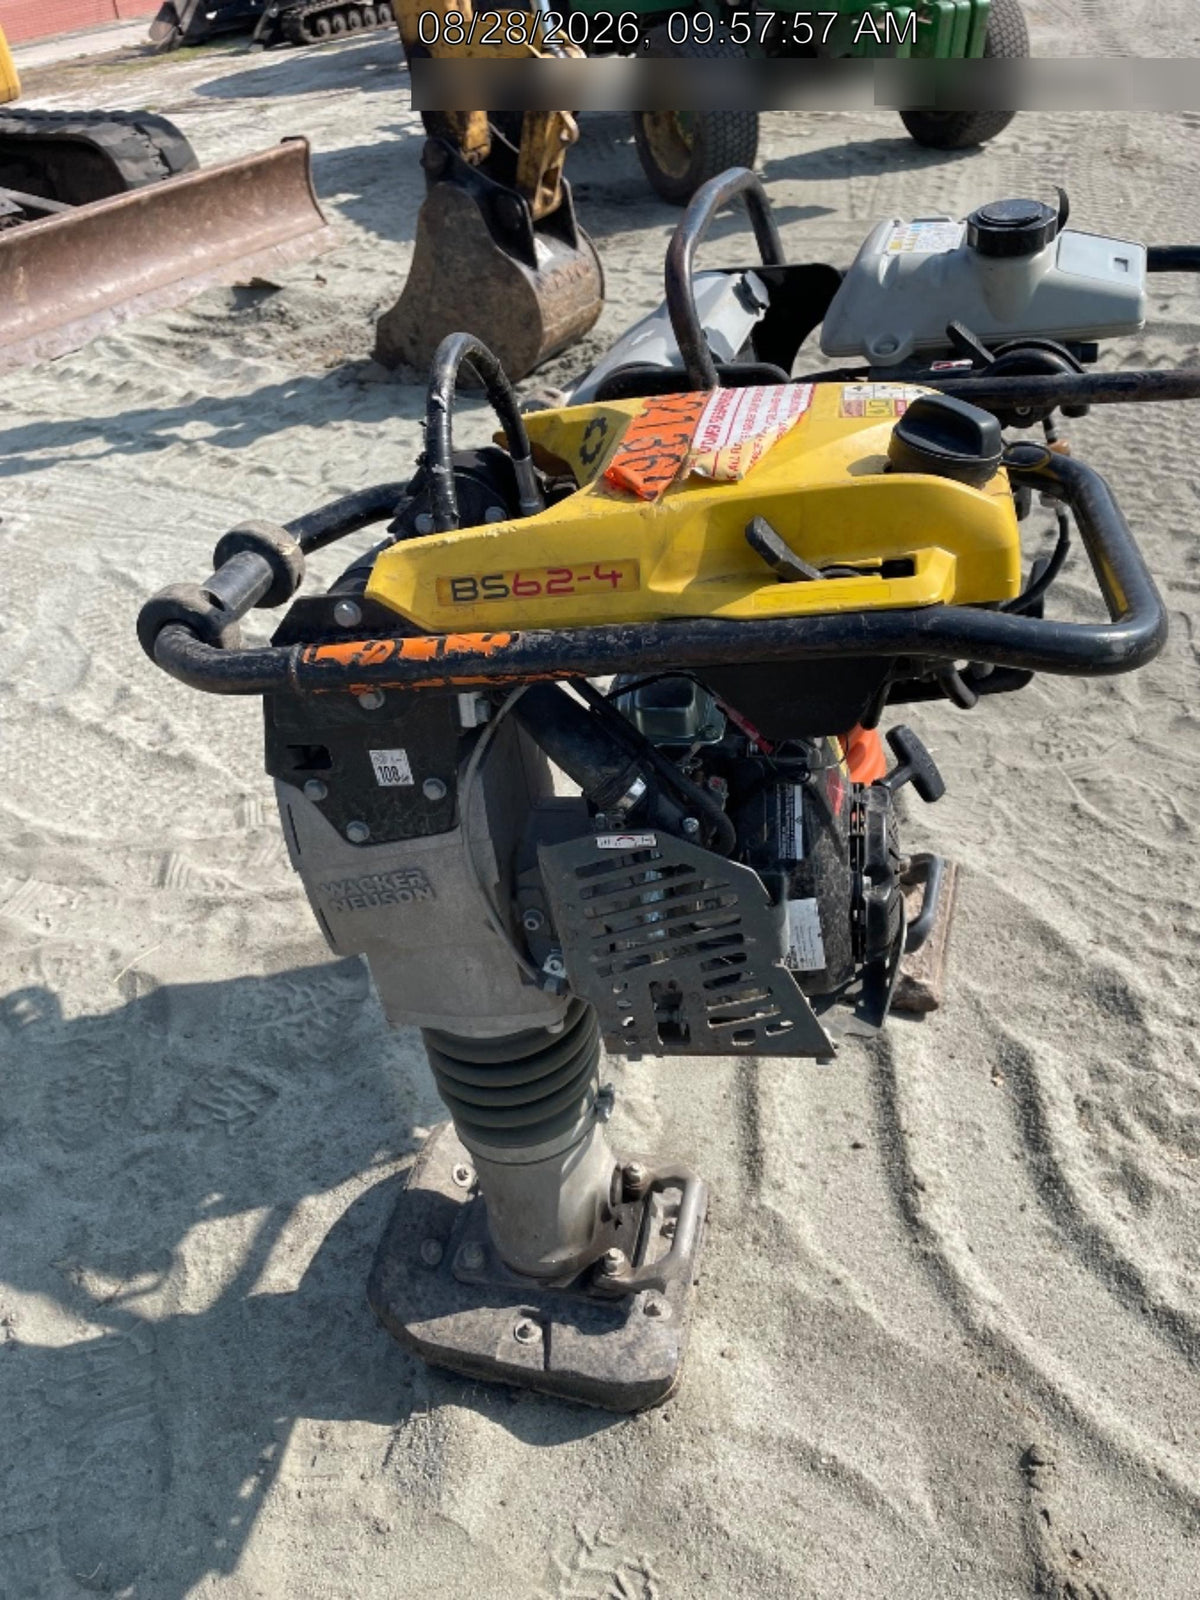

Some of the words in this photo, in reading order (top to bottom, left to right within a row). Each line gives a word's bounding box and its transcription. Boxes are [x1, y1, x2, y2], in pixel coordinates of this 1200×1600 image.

[451, 564, 622, 601] BS62-4
[319, 867, 429, 898] WACKER
[330, 883, 437, 911] NEUSON
